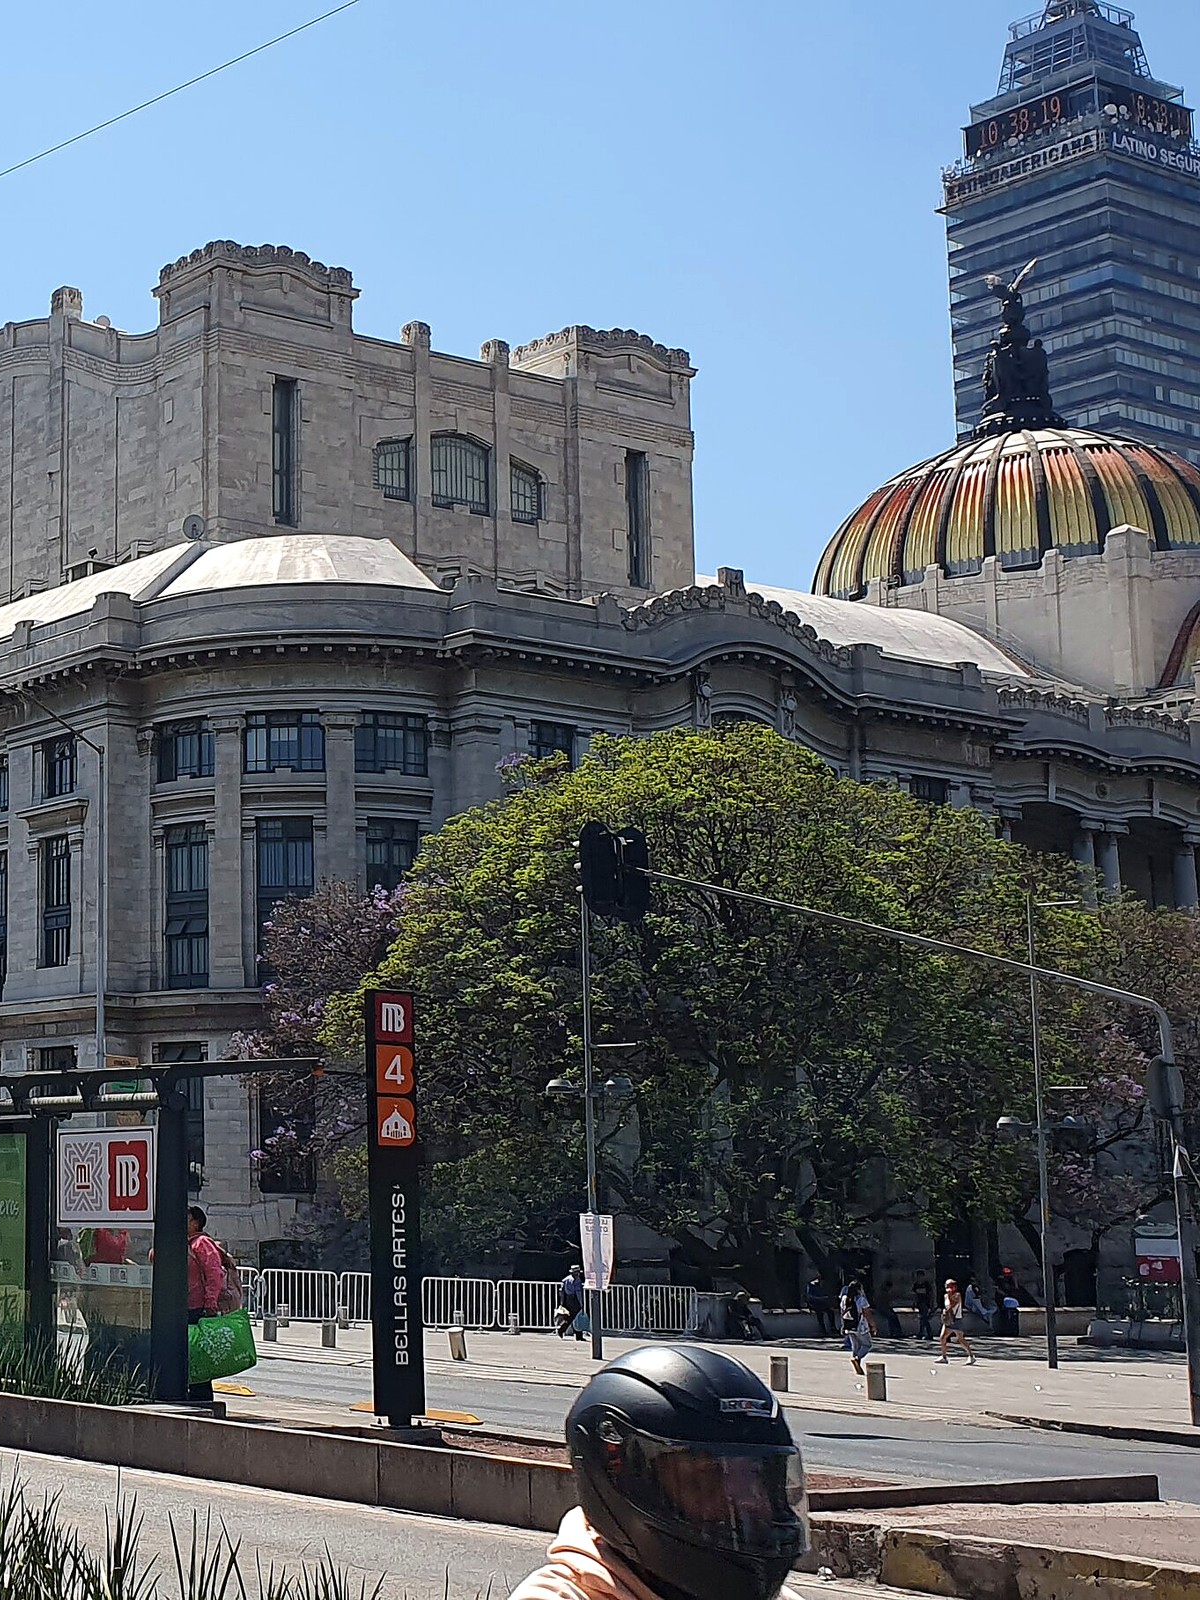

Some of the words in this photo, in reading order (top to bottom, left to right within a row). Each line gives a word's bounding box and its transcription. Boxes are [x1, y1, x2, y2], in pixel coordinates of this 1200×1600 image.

[979, 96, 1061, 149] 10:38:19
[1112, 131, 1157, 159] LATINO
[384, 1054, 405, 1085] 4
[392, 1193, 406, 1269] ARTES
[394, 1275, 409, 1365] BELLAS
